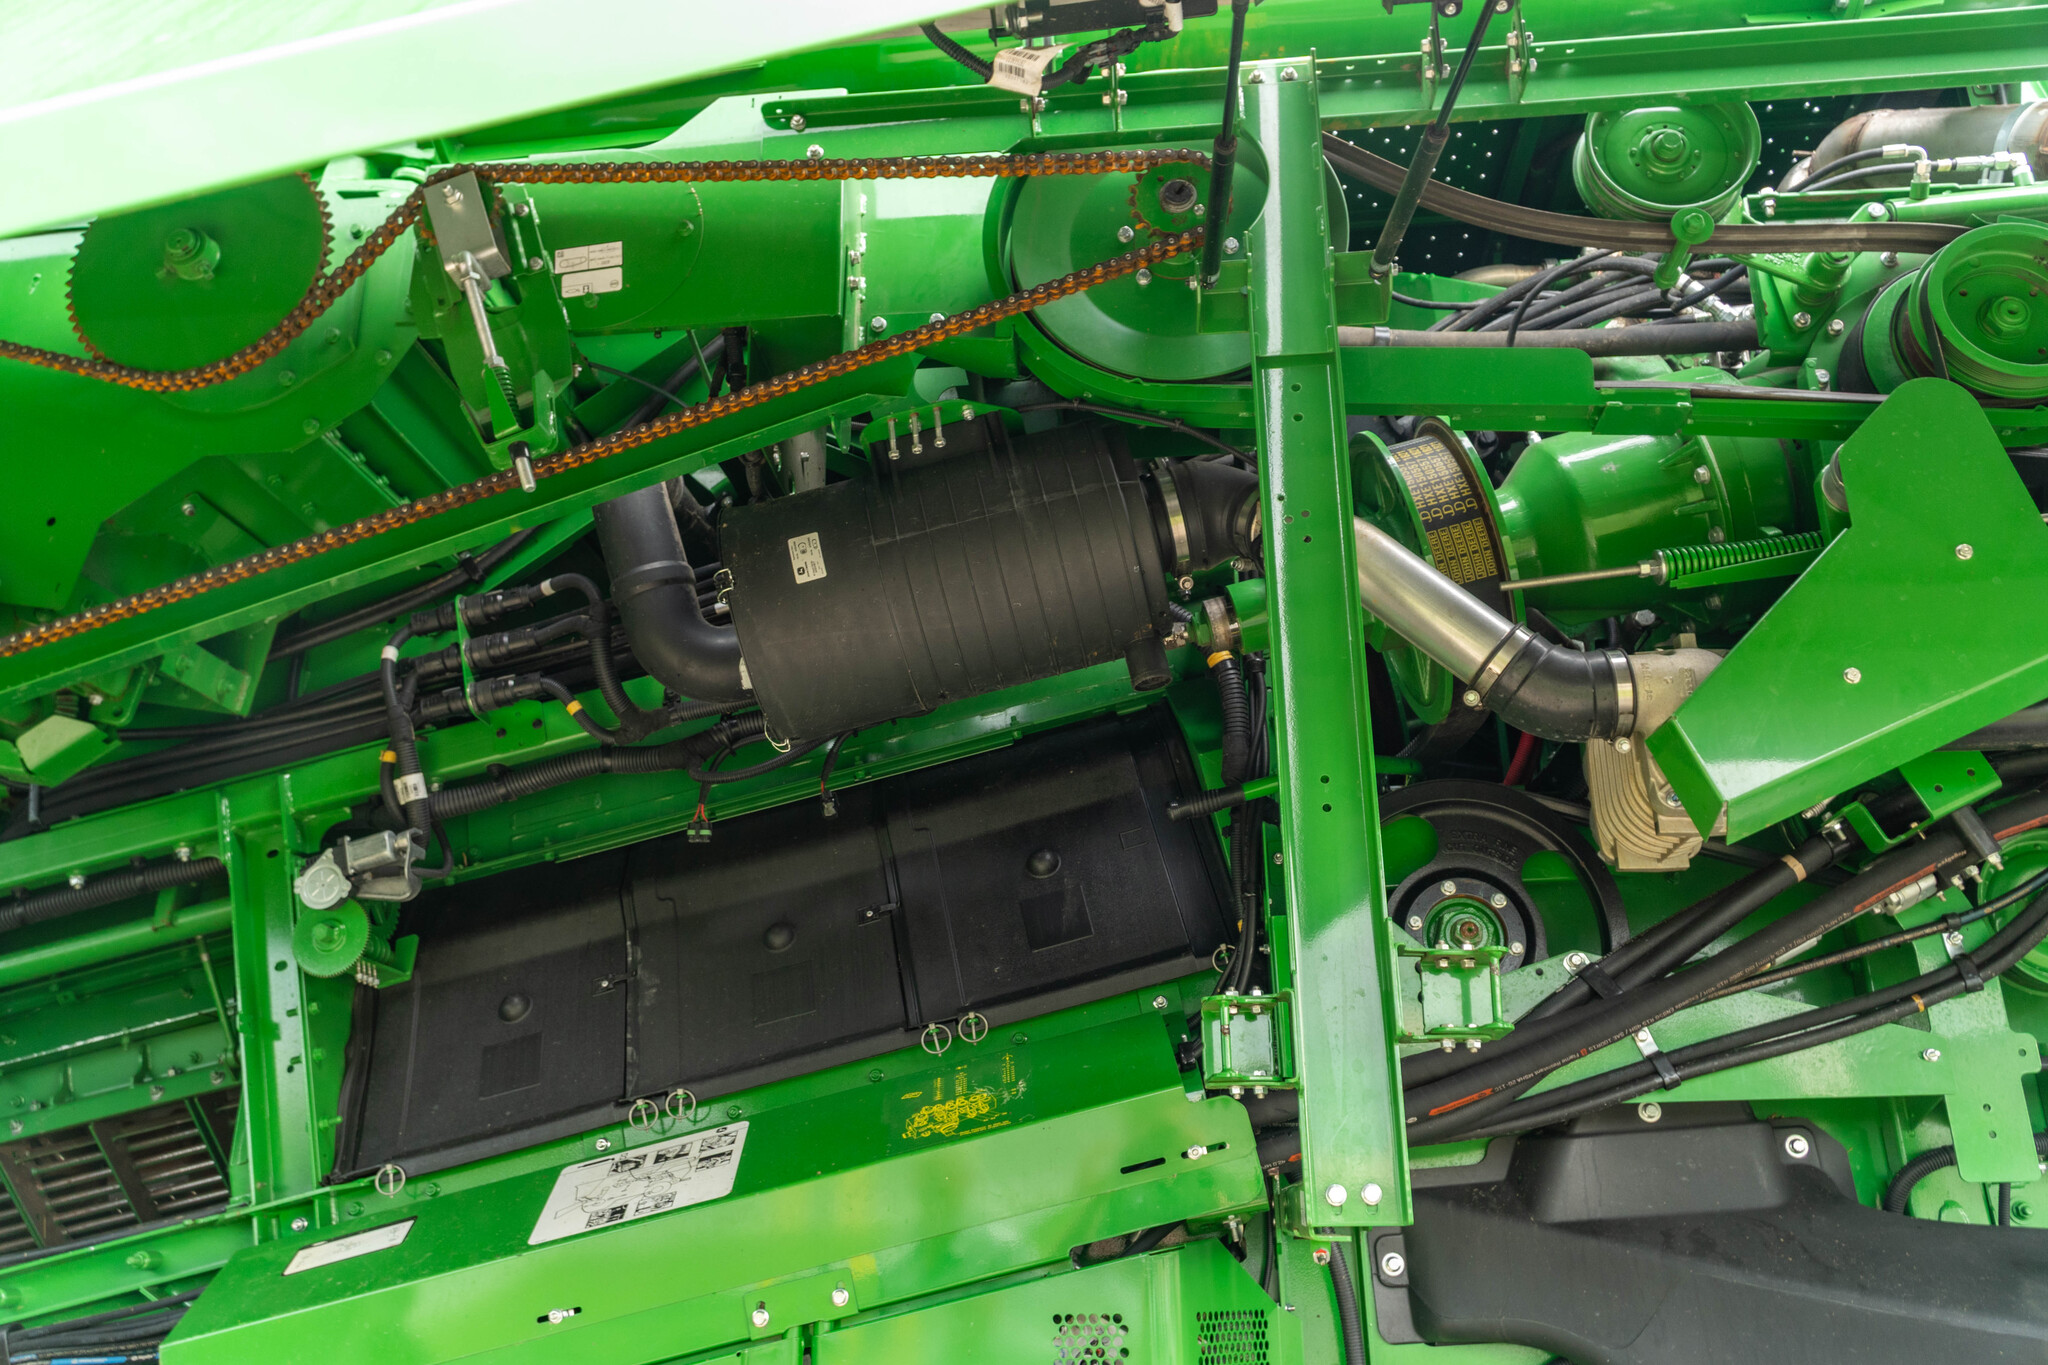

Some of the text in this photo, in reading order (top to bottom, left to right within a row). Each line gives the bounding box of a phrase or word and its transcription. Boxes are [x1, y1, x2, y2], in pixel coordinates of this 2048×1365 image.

[1406, 460, 1438, 506] HXE150557
[1417, 457, 1449, 503] HXE150557
[1428, 455, 1461, 500] HXE150557
[1439, 451, 1472, 497] HXE150557
[1429, 532, 1443, 560] DEERE
[1441, 529, 1455, 557] DEERE
[1452, 526, 1466, 554] DEERE
[1464, 523, 1477, 551] DEERE
[1474, 519, 1489, 548] DEERE
[1450, 560, 1463, 583] JOHN
[1461, 556, 1474, 580] JOHN
[1473, 553, 1485, 577] JOHN
[1484, 549, 1497, 574] JOHN
[1533, 1060, 1561, 1075] Resistant
[1560, 1052, 1579, 1063] Flame
[1516, 1072, 1534, 1083] MSHA
